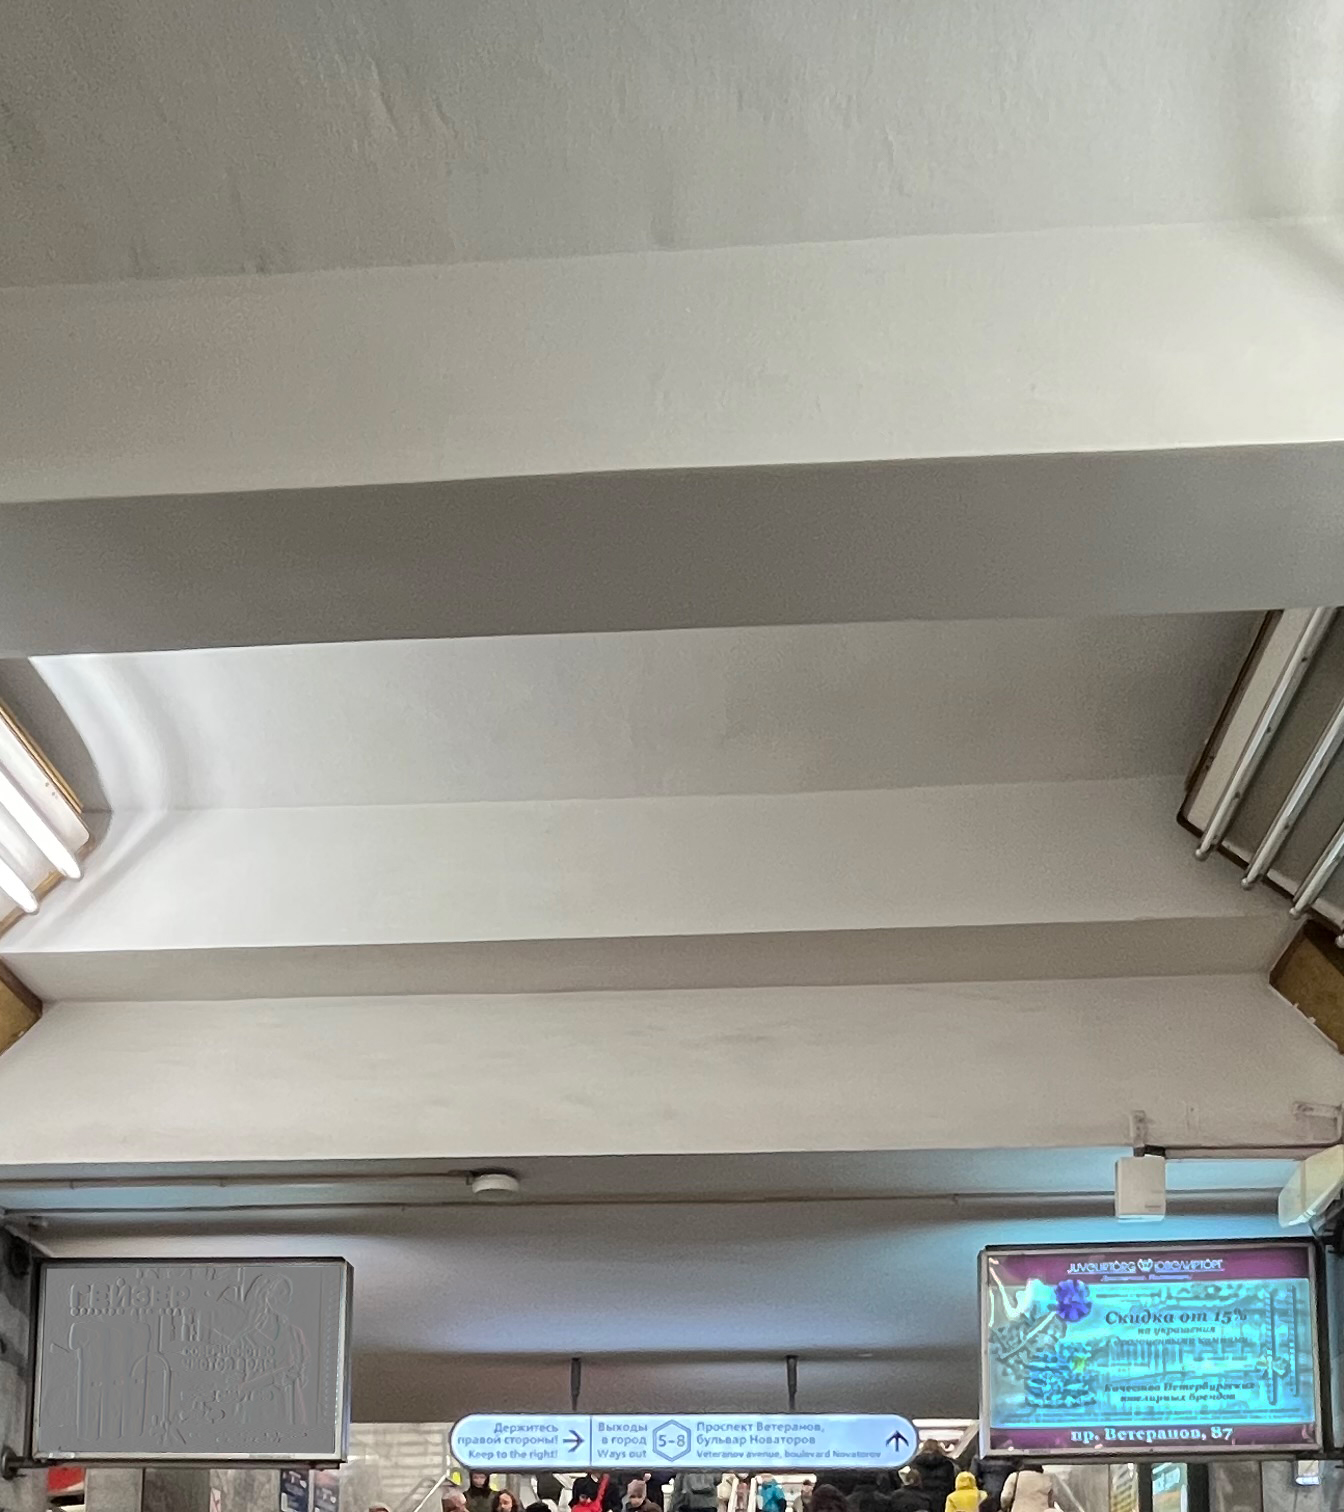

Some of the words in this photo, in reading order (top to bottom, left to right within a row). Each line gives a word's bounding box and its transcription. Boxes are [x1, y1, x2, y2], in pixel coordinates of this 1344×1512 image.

[1106, 1308, 1174, 1324] Скидка
[1180, 1312, 1206, 1322] от
[1214, 1308, 1247, 1324] 15%
[494, 1422, 559, 1434] Держитесь
[598, 1422, 648, 1433] Выходы
[696, 1422, 753, 1433] Проспект
[756, 1421, 825, 1433] Ветеранов,
[1071, 1429, 1099, 1444] пр.
[1104, 1426, 1207, 1443] Ветеранов,
[1211, 1425, 1234, 1441] 87
[457, 1435, 501, 1446] правой
[504, 1436, 558, 1446] стороны!
[601, 1437, 609, 1445] в
[611, 1437, 647, 1447] город
[696, 1434, 747, 1447] бульвар
[750, 1435, 816, 1446] Новаторов
[468, 1450, 494, 1460] Keep
[496, 1451, 507, 1459] to
[509, 1450, 527, 1459] the
[529, 1449, 558, 1460] right!
[597, 1450, 627, 1460] Ways
[629, 1450, 647, 1459] out
[696, 1450, 744, 1459] Veteranov
[785, 1449, 831, 1458] boulevard
[833, 1450, 881, 1459] Novatorov
